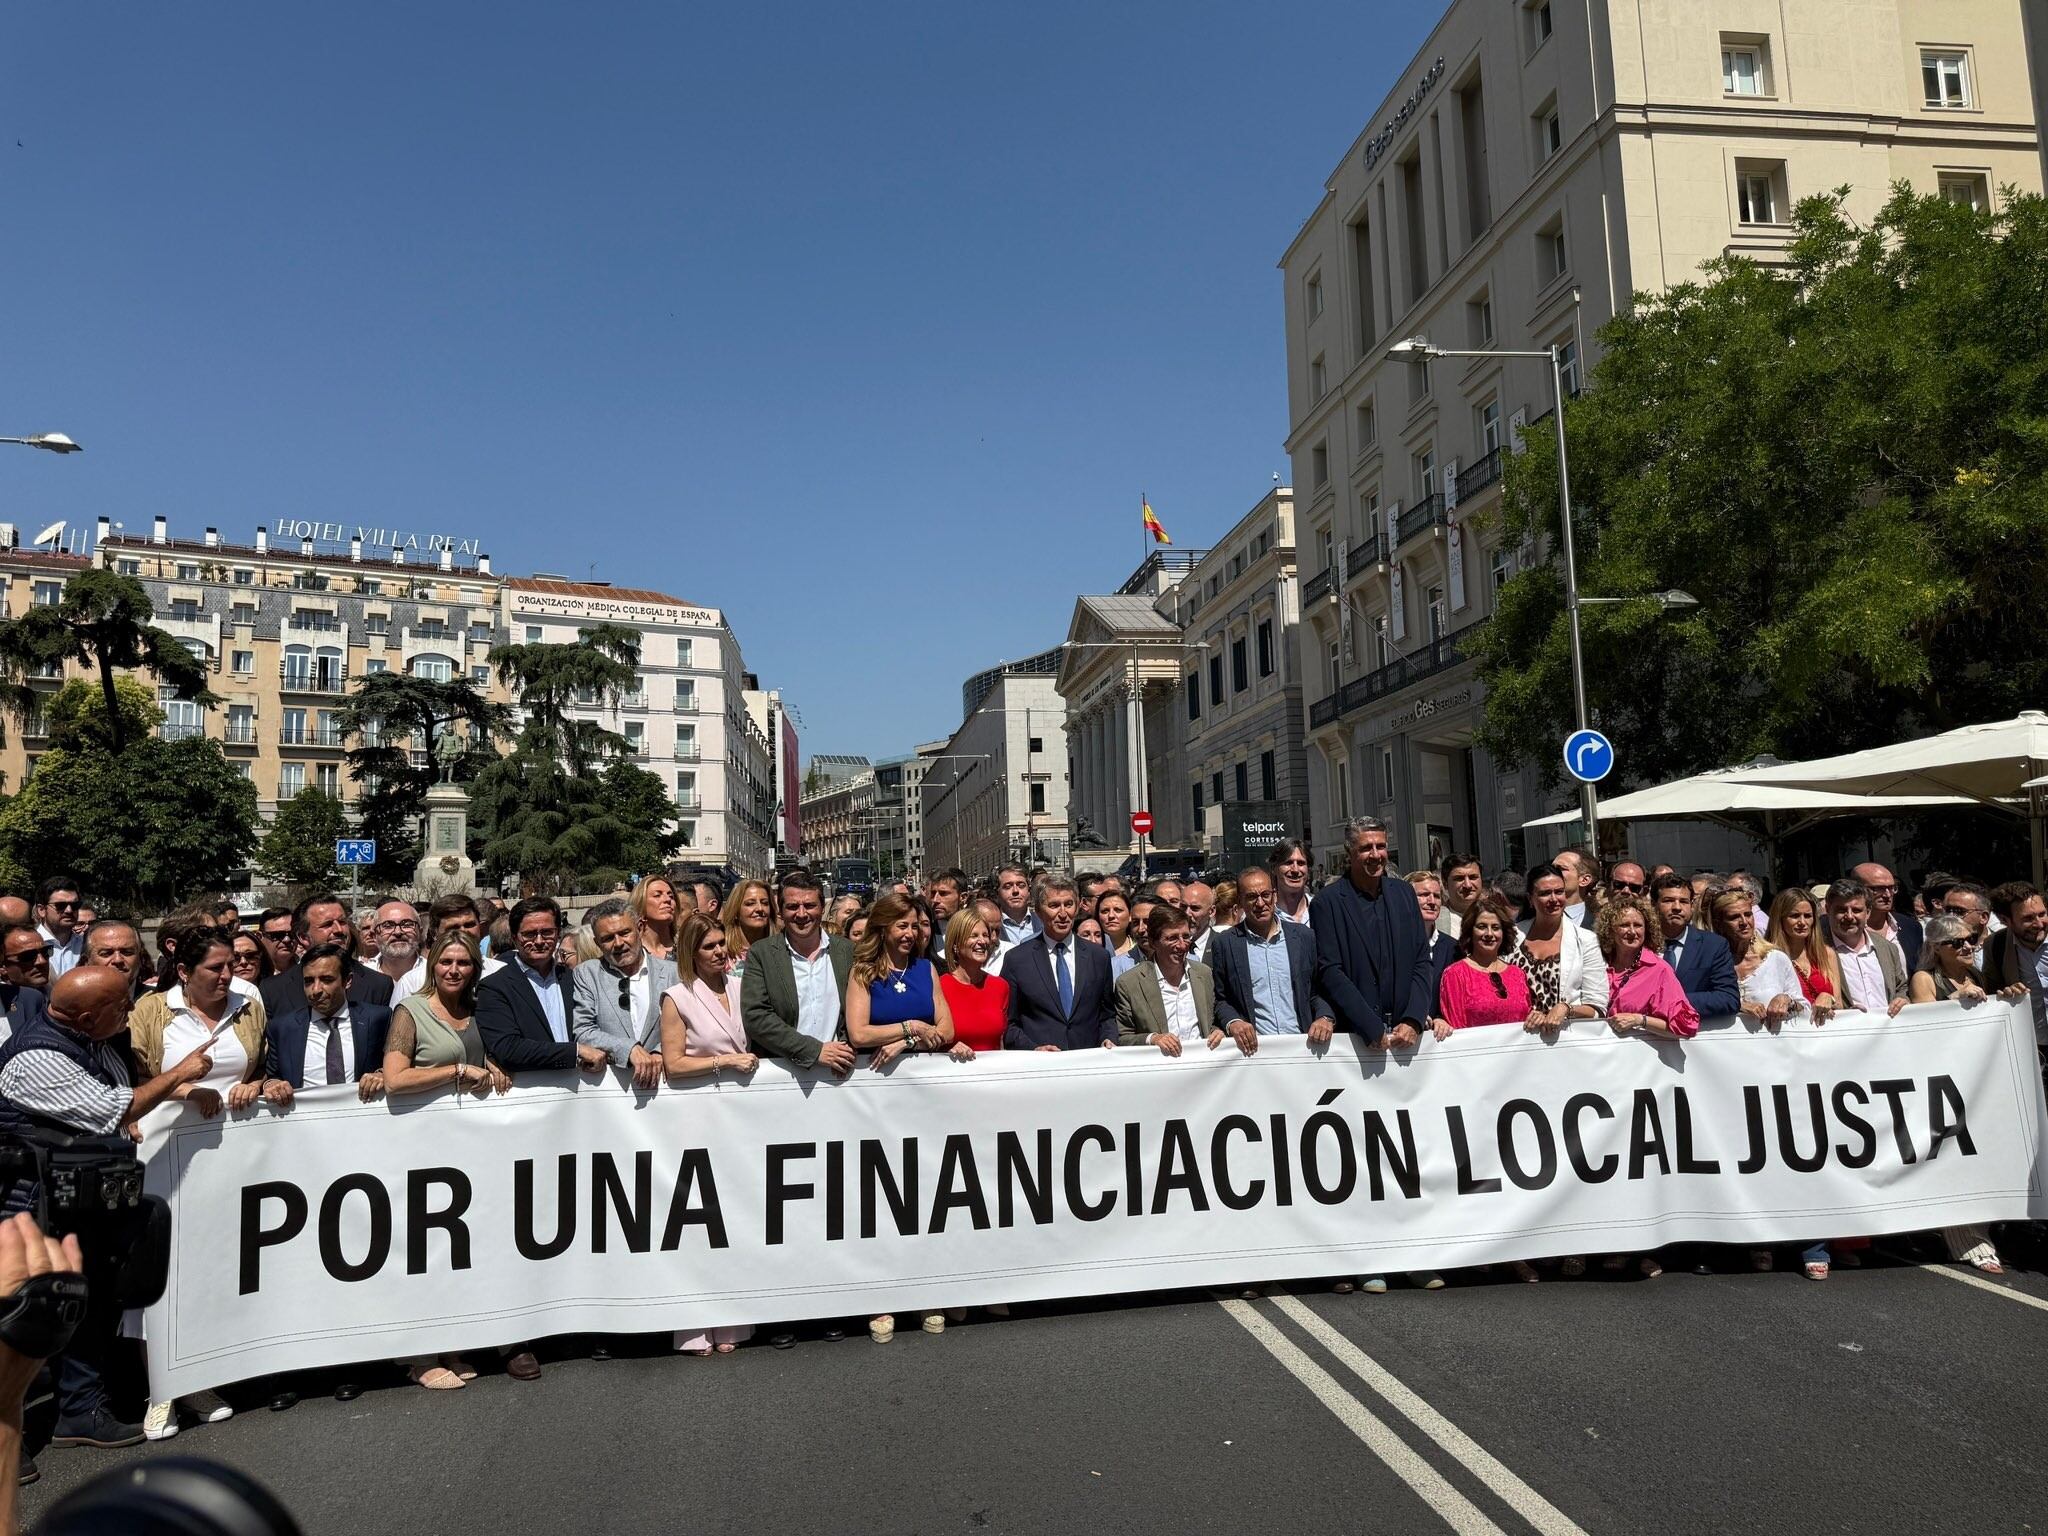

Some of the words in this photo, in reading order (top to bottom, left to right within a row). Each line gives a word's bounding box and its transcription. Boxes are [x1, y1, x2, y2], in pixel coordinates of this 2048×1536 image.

[277, 518, 343, 541] HOTEL
[358, 526, 418, 549] VILLA
[428, 534, 483, 556] REAL
[517, 595, 585, 609] ORGANIZACIÓN
[587, 602, 621, 613] MÉDICA
[622, 606, 665, 617] COLEGIAL
[666, 609, 678, 618] DE
[680, 610, 712, 621] ESPAÑA
[1414, 699, 1435, 719] Ges
[1242, 821, 1285, 834] telpark
[1244, 836, 1275, 844] CORTES
[239, 1167, 472, 1296] POR
[514, 1149, 730, 1261] UNA
[765, 1089, 1422, 1246] FINANCIACIÓN
[1444, 1086, 1721, 1195] LOCAL
[1737, 1074, 1978, 1175] JUSTA
